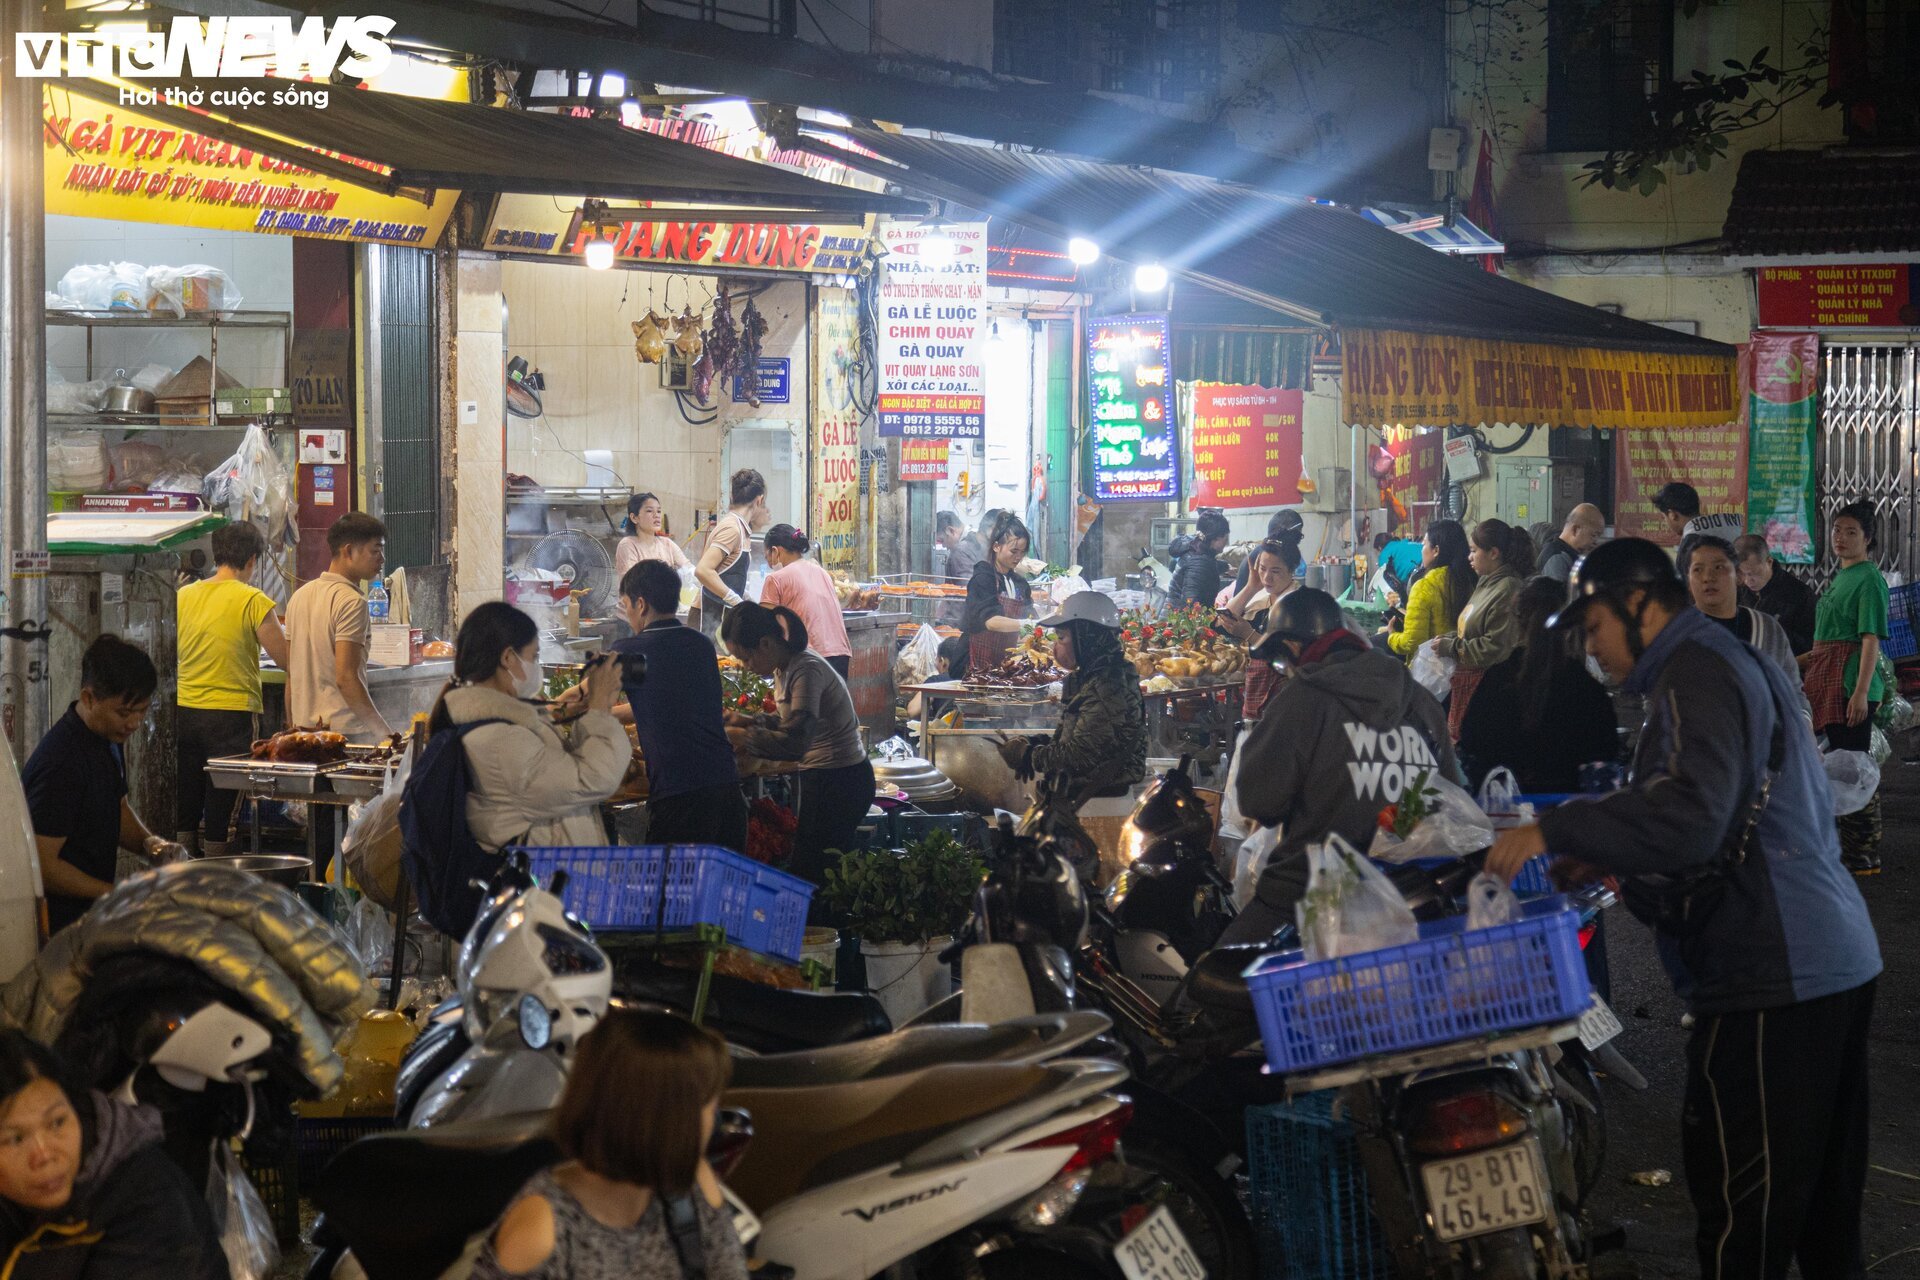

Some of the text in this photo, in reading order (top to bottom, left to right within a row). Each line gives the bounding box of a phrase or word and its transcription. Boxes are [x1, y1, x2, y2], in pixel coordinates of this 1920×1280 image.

[119, 126, 176, 161] VỊT
[719, 222, 820, 268] DUNG
[886, 261, 935, 275] NHẬN
[1765, 269, 1776, 283] BỘ
[1777, 268, 1801, 283] PHẬN:
[1816, 266, 1844, 280] QUẢN
[1846, 268, 1858, 280] LÝ
[921, 277, 943, 298] THỐNG
[944, 284, 963, 298] CHAY
[1817, 281, 1893, 296] QUẢN LÝ ĐÔ THỊ
[1818, 296, 1883, 309] QUẢN LÝ NHÀ
[888, 302, 977, 323] GÀ LỄ LUỘC
[1818, 312, 1869, 325] ĐỊA CHÍNH
[889, 326, 975, 339] CHIM QUAY
[899, 343, 964, 359] GÀ QUAY
[885, 364, 980, 380] VỊT QUAY LẠNG SƠN
[886, 379, 978, 394] XÔI CÁC LOẠI...
[882, 397, 900, 409] NGON
[901, 396, 915, 411] ĐẶC
[916, 396, 931, 411] BIỆT
[935, 396, 947, 409] GIÁ
[958, 398, 972, 412] HỢP
[972, 397, 981, 410] LÝ
[1144, 400, 1162, 420] &
[884, 415, 980, 425] ĐT: 0978 5555 66
[823, 414, 841, 446] GÀ
[903, 425, 980, 436] 0912 287 640
[1265, 432, 1279, 443] 40K
[1695, 431, 1711, 442] THEO
[1712, 431, 1724, 442] QUY
[1265, 449, 1279, 460] 30K
[824, 451, 857, 489] LUỘC
[1210, 467, 1226, 482] BIỆT
[1265, 467, 1279, 477] 60K
[1122, 484, 1138, 493] GIA
[1254, 485, 1274, 496] khách
[84, 499, 130, 507] ANNAPURNA
[828, 494, 853, 523] XÔI
[1692, 514, 1720, 532] DIOR
[841, 1176, 968, 1222] VISION
[1441, 1185, 1538, 1235] 464.49
